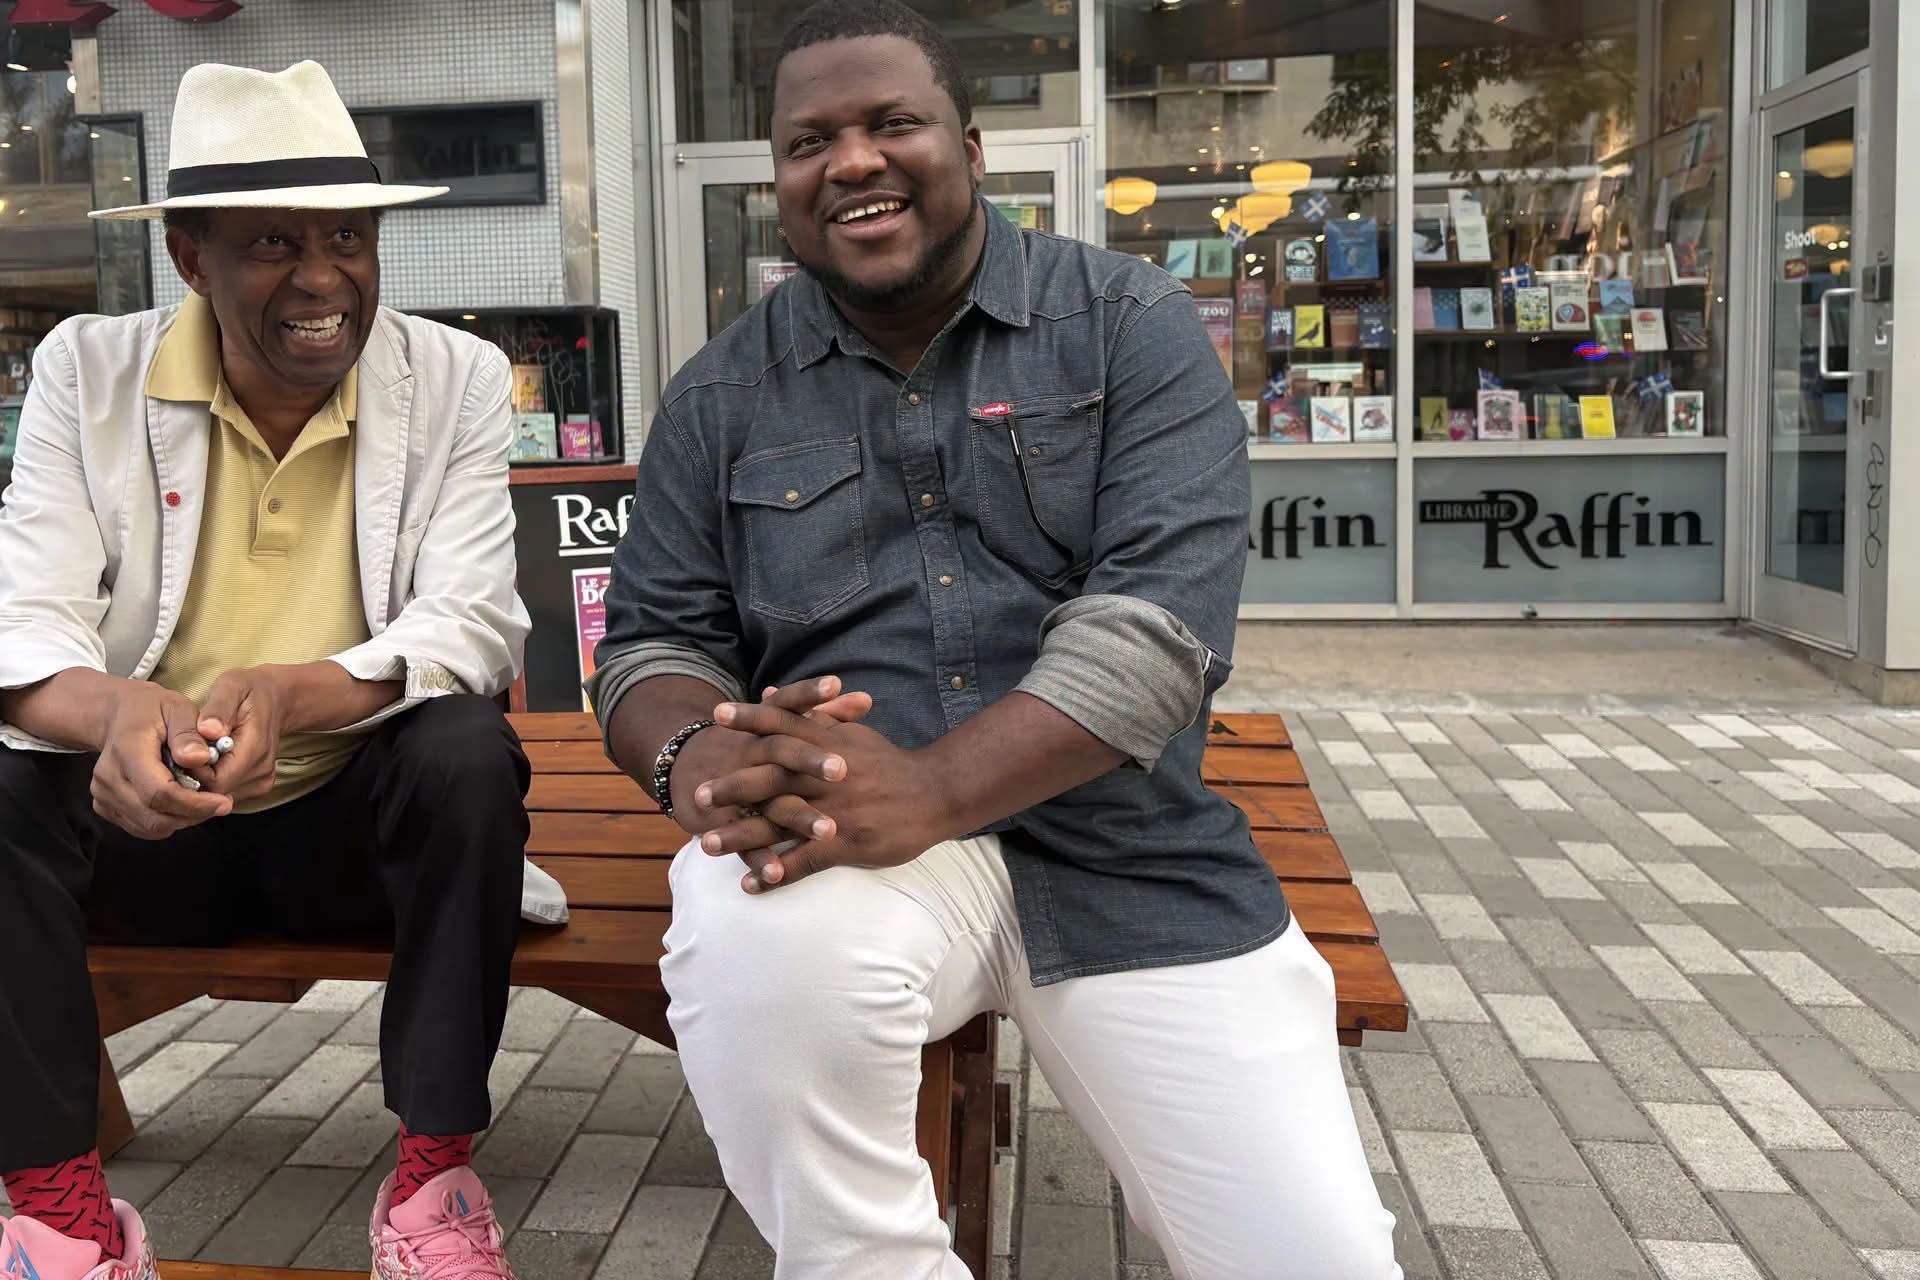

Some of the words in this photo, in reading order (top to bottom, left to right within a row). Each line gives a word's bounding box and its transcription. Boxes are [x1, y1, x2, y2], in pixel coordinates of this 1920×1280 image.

[1199, 306, 1229, 317] ZOU
[551, 494, 637, 547] Raf
[1247, 496, 1387, 560] ffin
[1423, 503, 1512, 521] LIBRAIRIE
[1479, 489, 1713, 570] Raffin
